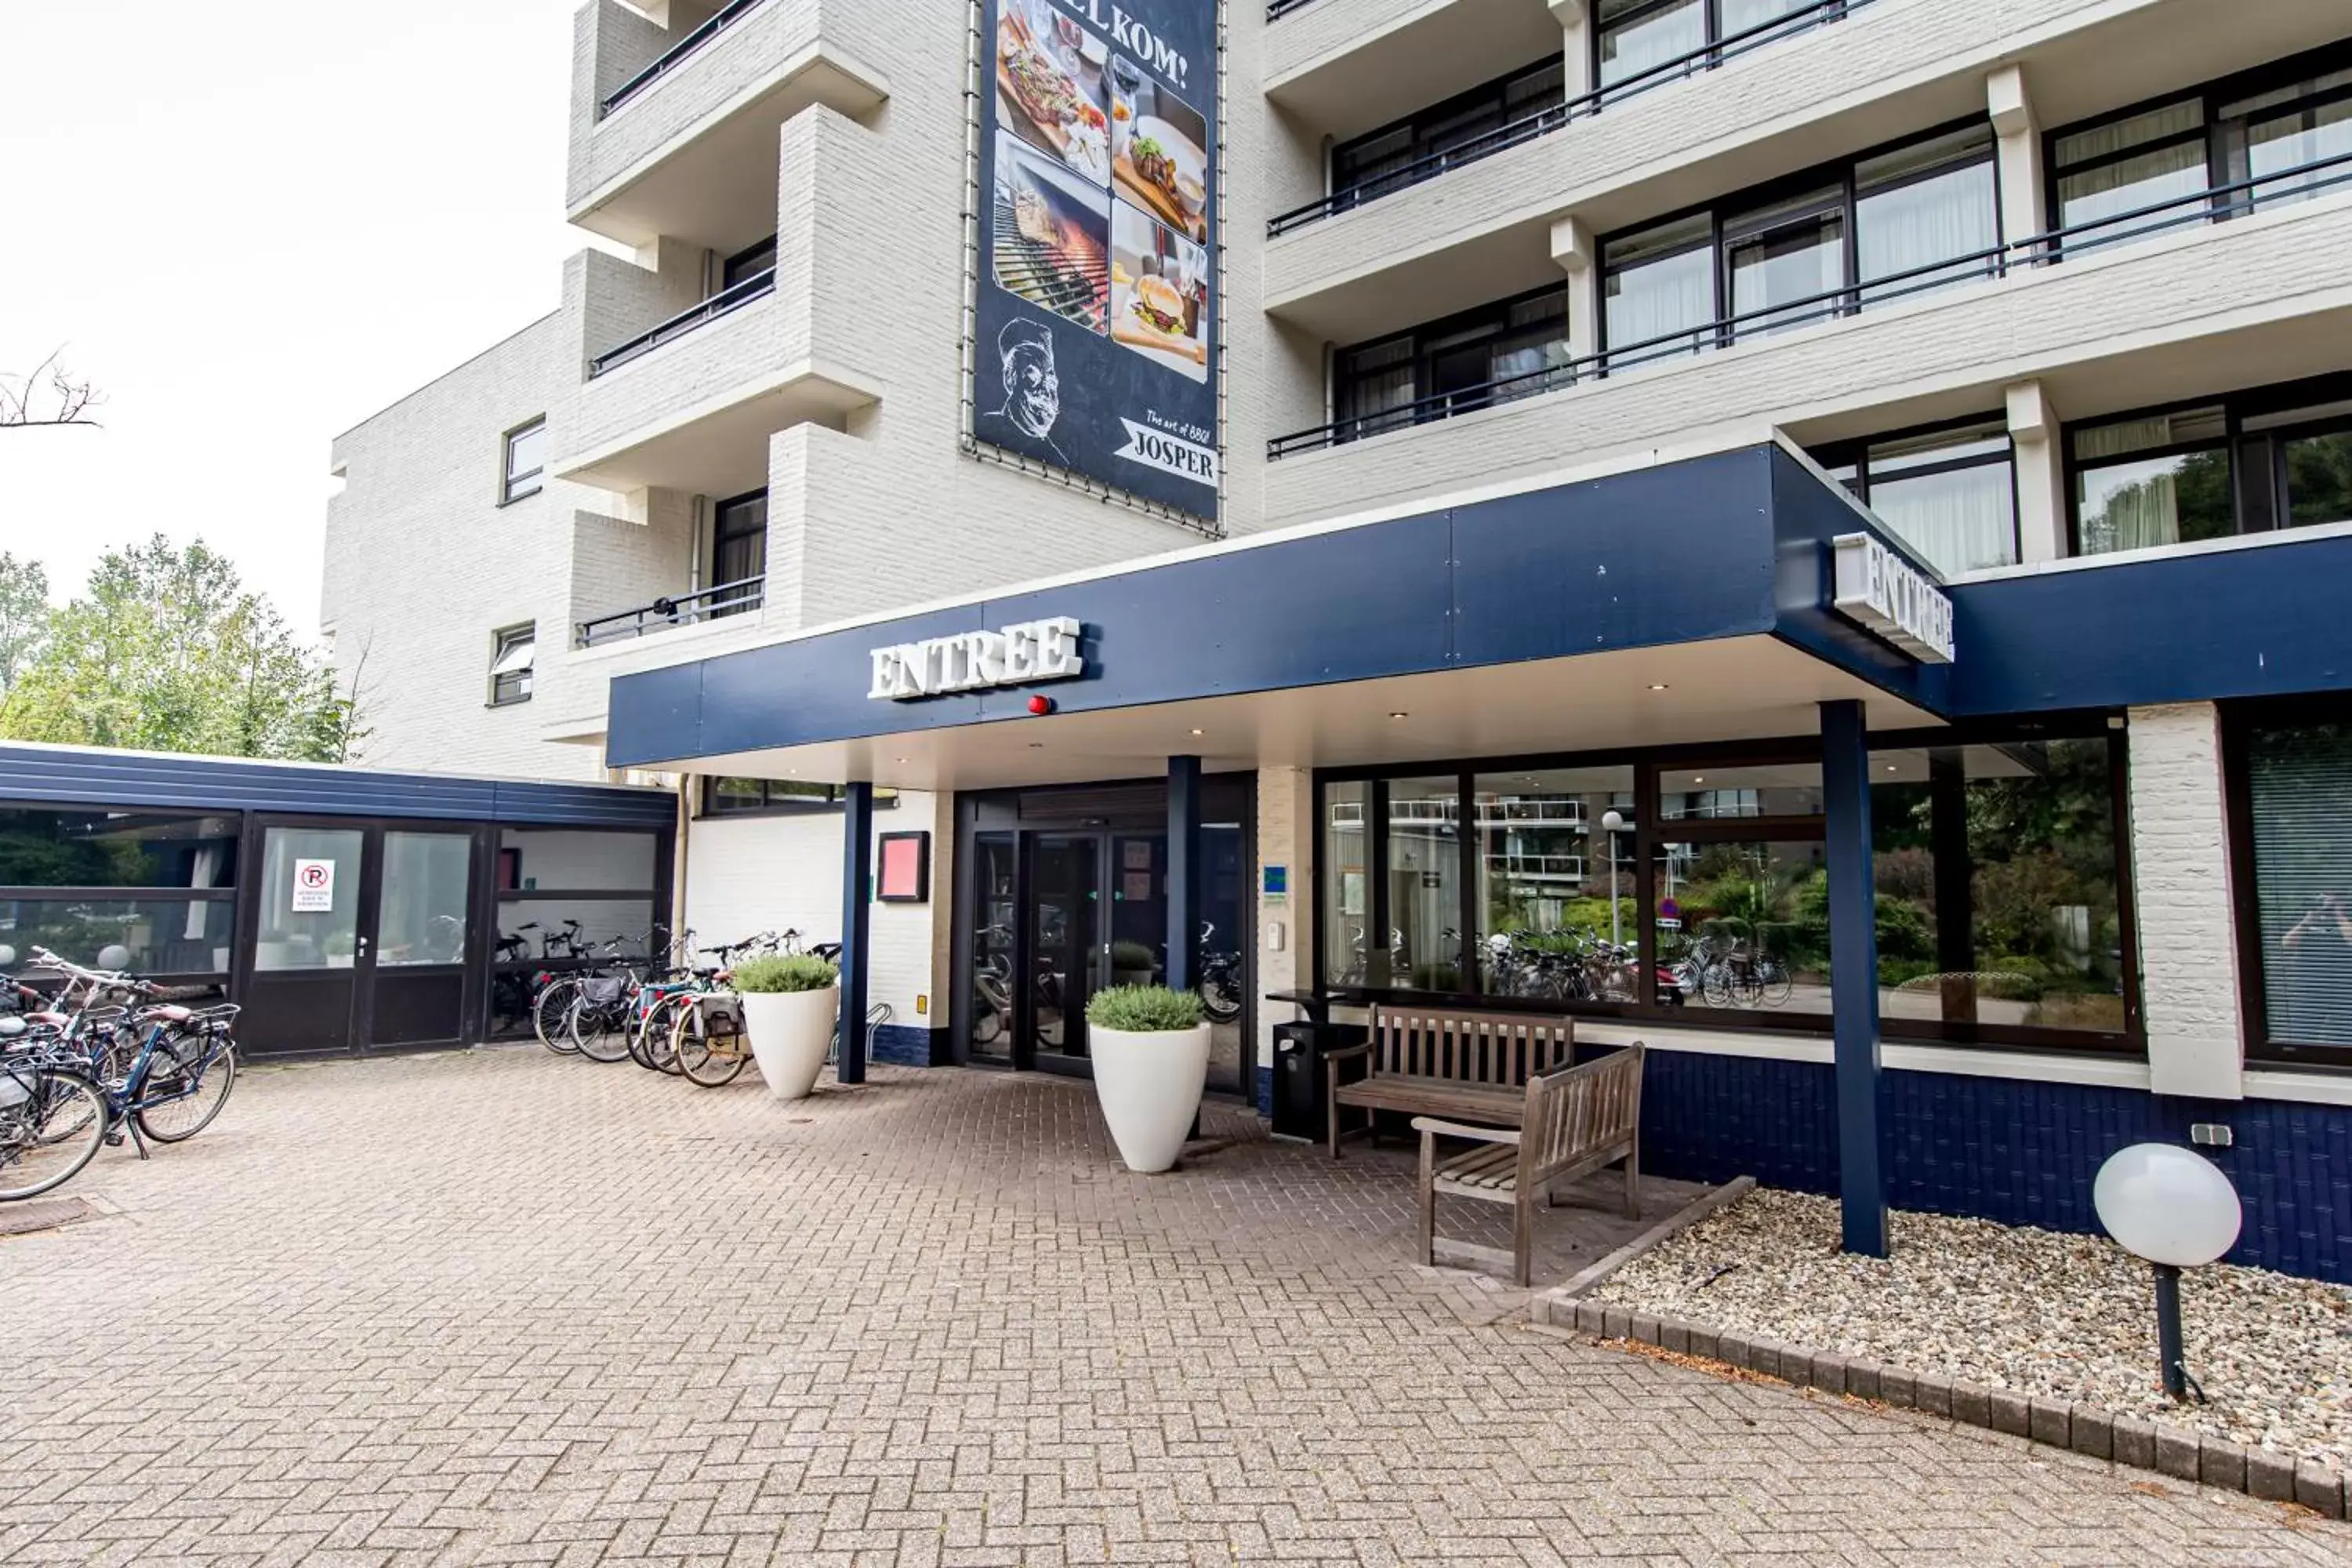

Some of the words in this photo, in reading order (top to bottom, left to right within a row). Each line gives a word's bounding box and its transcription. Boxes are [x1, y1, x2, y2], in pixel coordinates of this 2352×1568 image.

[1062, 0, 1188, 89] LKOM!
[1134, 430, 1213, 478] JOSPER
[1147, 408, 1162, 426] The
[1163, 419, 1178, 432] art
[1179, 423, 1189, 437] of
[867, 615, 1083, 699] ENTREE
